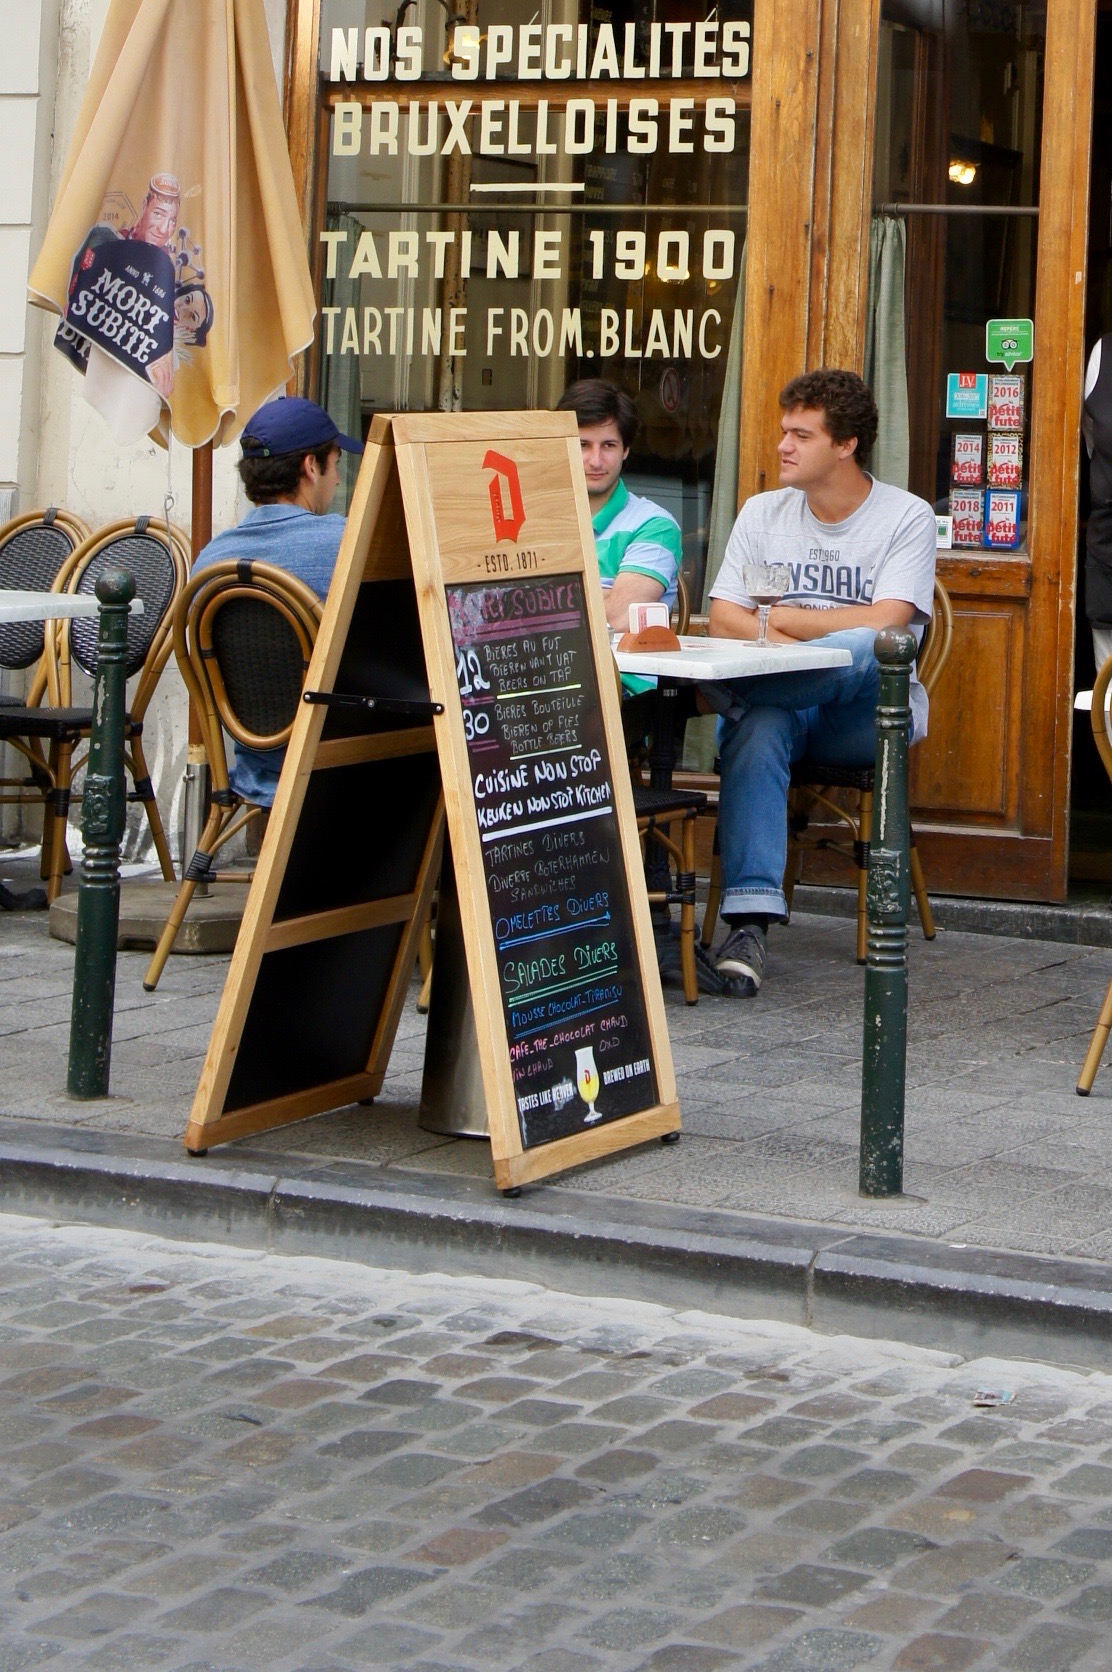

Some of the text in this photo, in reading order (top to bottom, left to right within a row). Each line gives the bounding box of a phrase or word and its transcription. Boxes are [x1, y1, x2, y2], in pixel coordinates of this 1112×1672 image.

[330, 9, 750, 81] NOS SPÉCIALITÉS
[332, 98, 736, 155] BRUXELLOISES
[320, 229, 735, 280] TARTINE 1900
[125, 265, 140, 279] ANNO
[90, 268, 169, 333] MORT
[71, 290, 158, 364] SUBITE
[322, 307, 467, 356] TARTINE
[994, 387, 1018, 398] 2016
[989, 405, 1020, 418] petit
[957, 443, 980, 453] 2014
[994, 445, 1017, 454] 2012
[951, 463, 982, 475] petit
[990, 464, 1019, 476] petit
[953, 500, 979, 512] 2018
[991, 502, 1014, 512] 2011
[986, 523, 1017, 535] petit
[485, 551, 538, 573] ESTD. 1871
[523, 640, 536, 653] AU
[542, 636, 561, 652] FUT
[556, 650, 577, 666] VAT
[457, 650, 490, 695] 12
[498, 667, 572, 691] BEERS ON TAP
[463, 710, 490, 740] 30
[543, 720, 553, 733] OP
[511, 737, 543, 755] BOTTLE
[534, 760, 567, 784] NON
[570, 749, 601, 777] STOP
[477, 800, 523, 828] KEUKEN
[527, 796, 550, 814] NON
[551, 786, 573, 809] STOP
[495, 904, 560, 939] OMELETTES
[503, 954, 566, 994] SALADES
[512, 1006, 545, 1027] MOUSSE
[600, 1015, 628, 1031] CHAUD
[603, 1058, 651, 1085] BREWED ON EARTH
[518, 1093, 539, 1112] TASTES
[540, 1089, 552, 1106] LIKE
